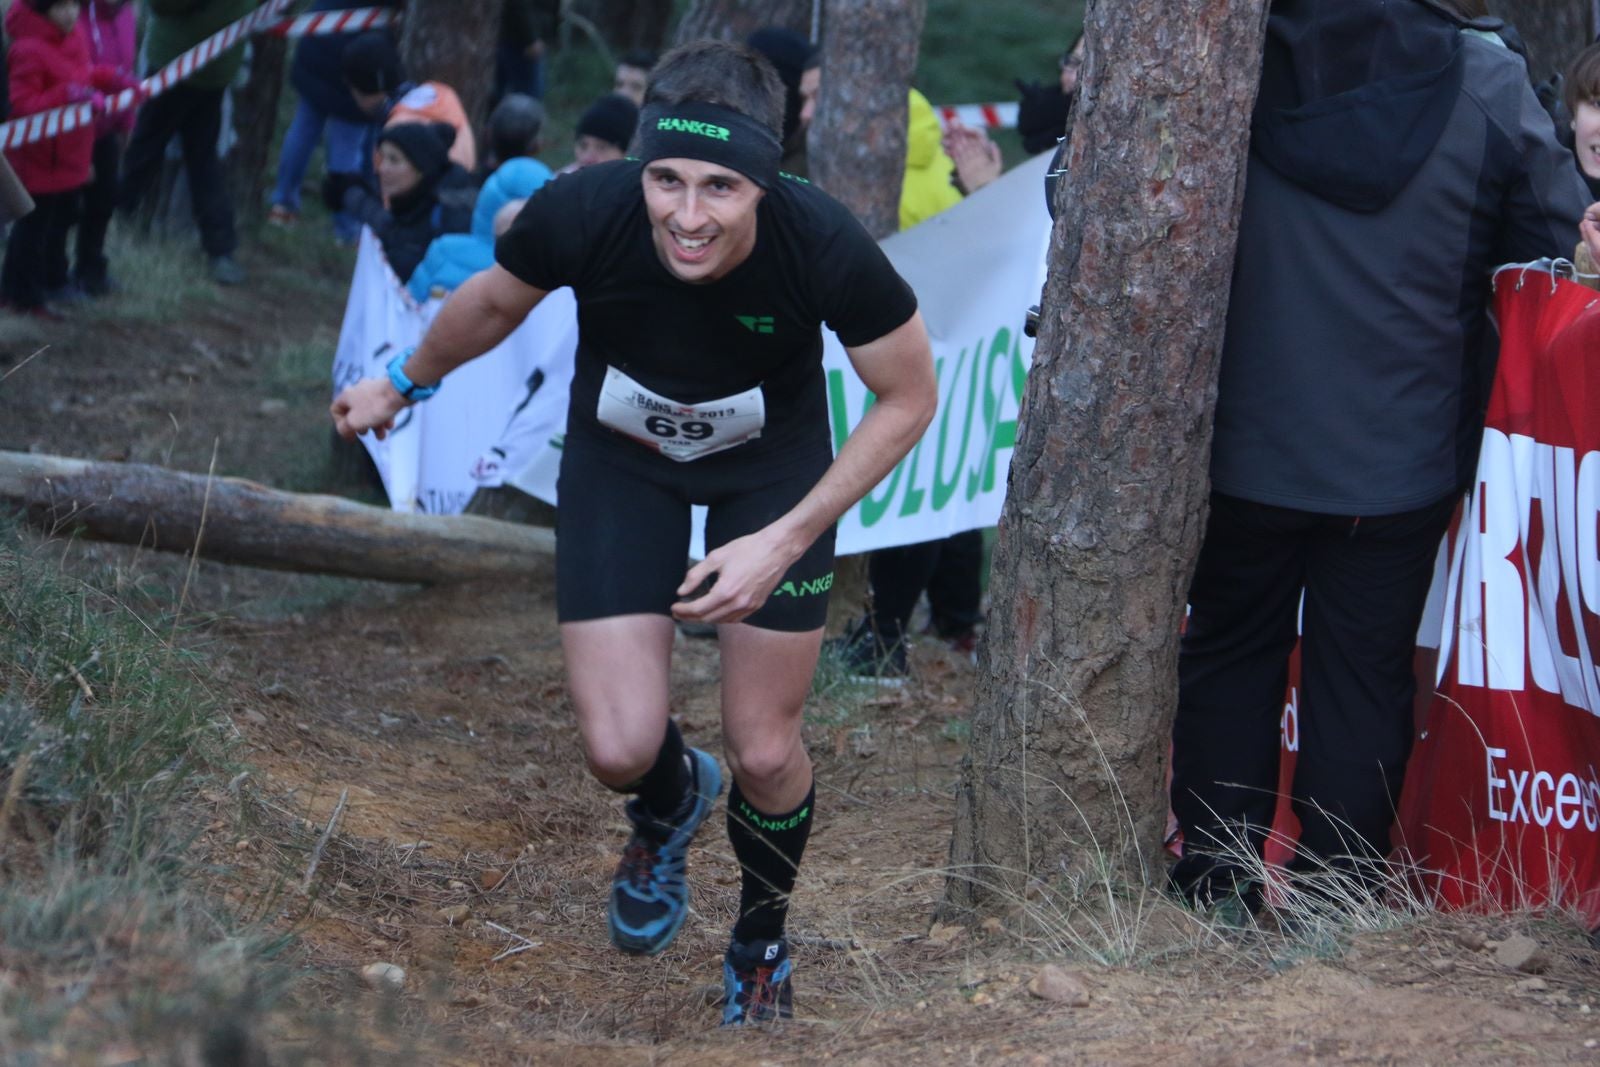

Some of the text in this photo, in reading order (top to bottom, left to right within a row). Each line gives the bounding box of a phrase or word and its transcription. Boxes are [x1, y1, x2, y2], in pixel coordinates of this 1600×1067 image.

[657, 118, 730, 141] HANKER
[645, 416, 714, 440] 69
[740, 802, 809, 831] HANKER
